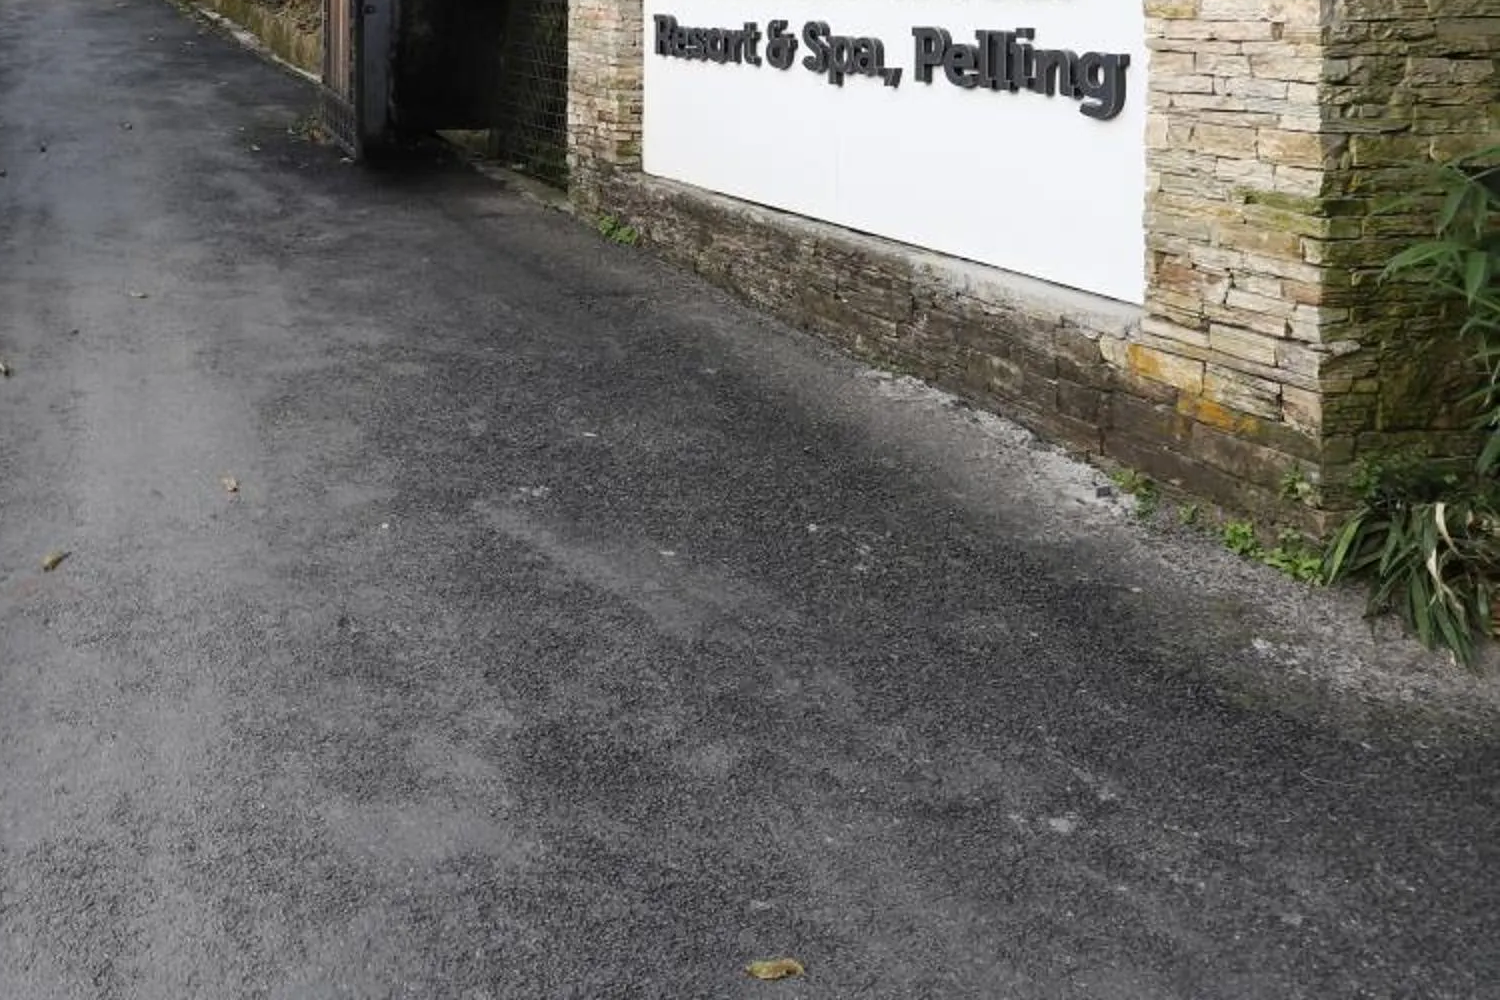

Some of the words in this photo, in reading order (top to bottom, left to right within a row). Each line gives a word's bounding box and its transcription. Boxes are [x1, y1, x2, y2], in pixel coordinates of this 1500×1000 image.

[654, 15, 762, 67] Resort
[766, 19, 799, 70] &
[802, 21, 902, 88] Spa,
[911, 27, 1131, 121] Pelling
